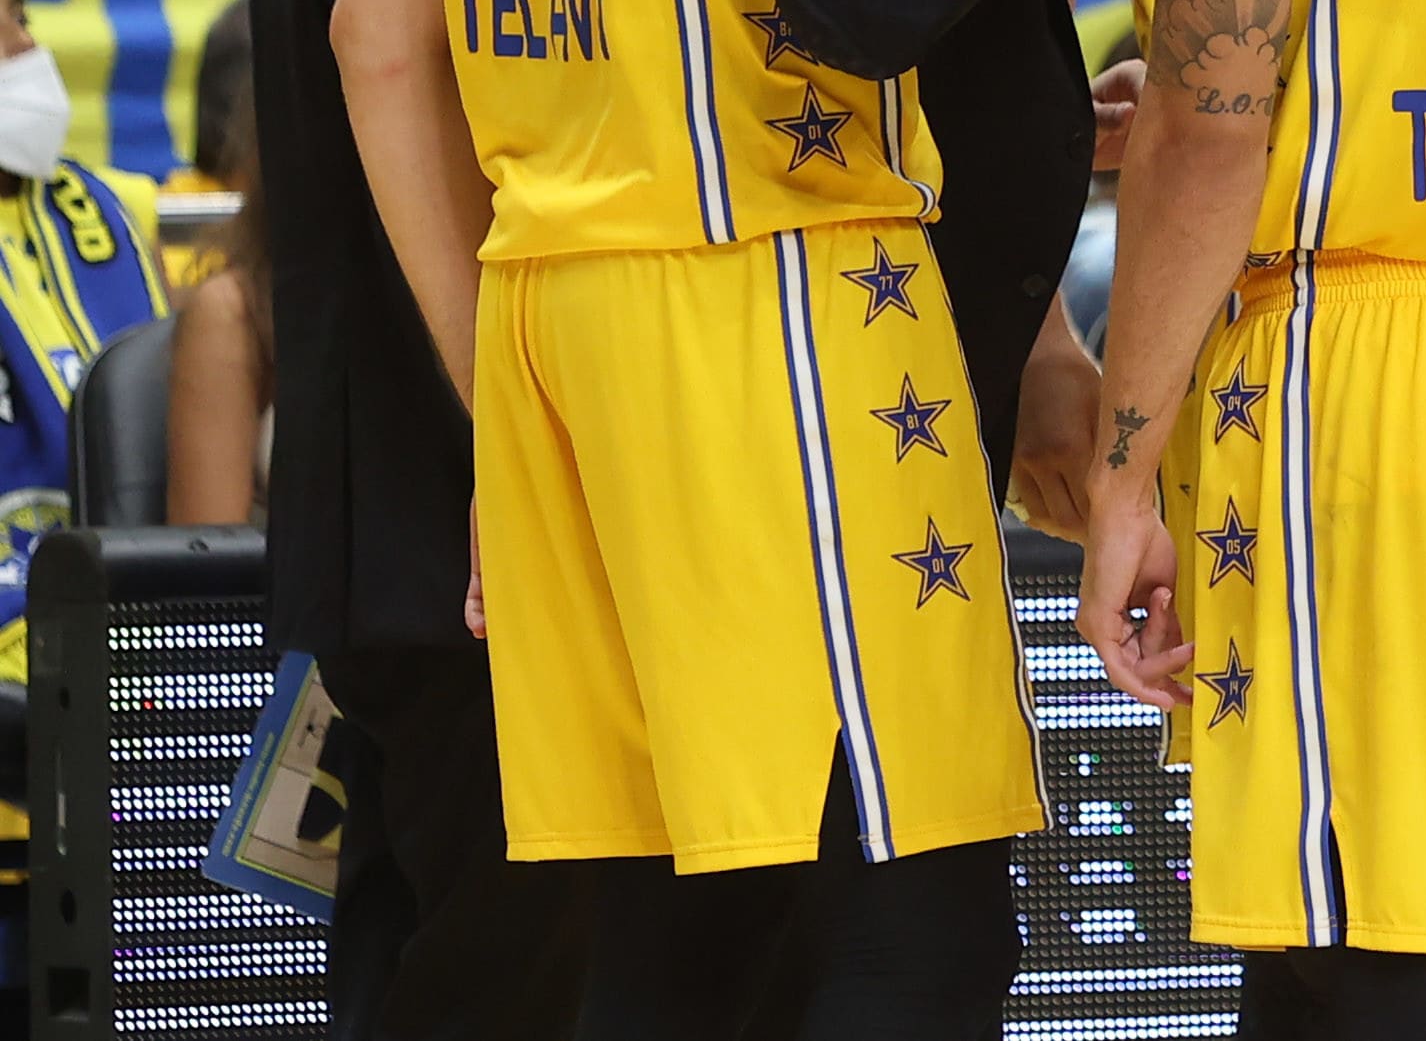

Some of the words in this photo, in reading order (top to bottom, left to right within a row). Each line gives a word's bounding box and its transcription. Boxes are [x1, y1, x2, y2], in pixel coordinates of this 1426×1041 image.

[878, 275, 894, 291] 77
[1227, 394, 1242, 412] 04
[905, 413, 920, 430] 81
[1226, 538, 1242, 555] 05
